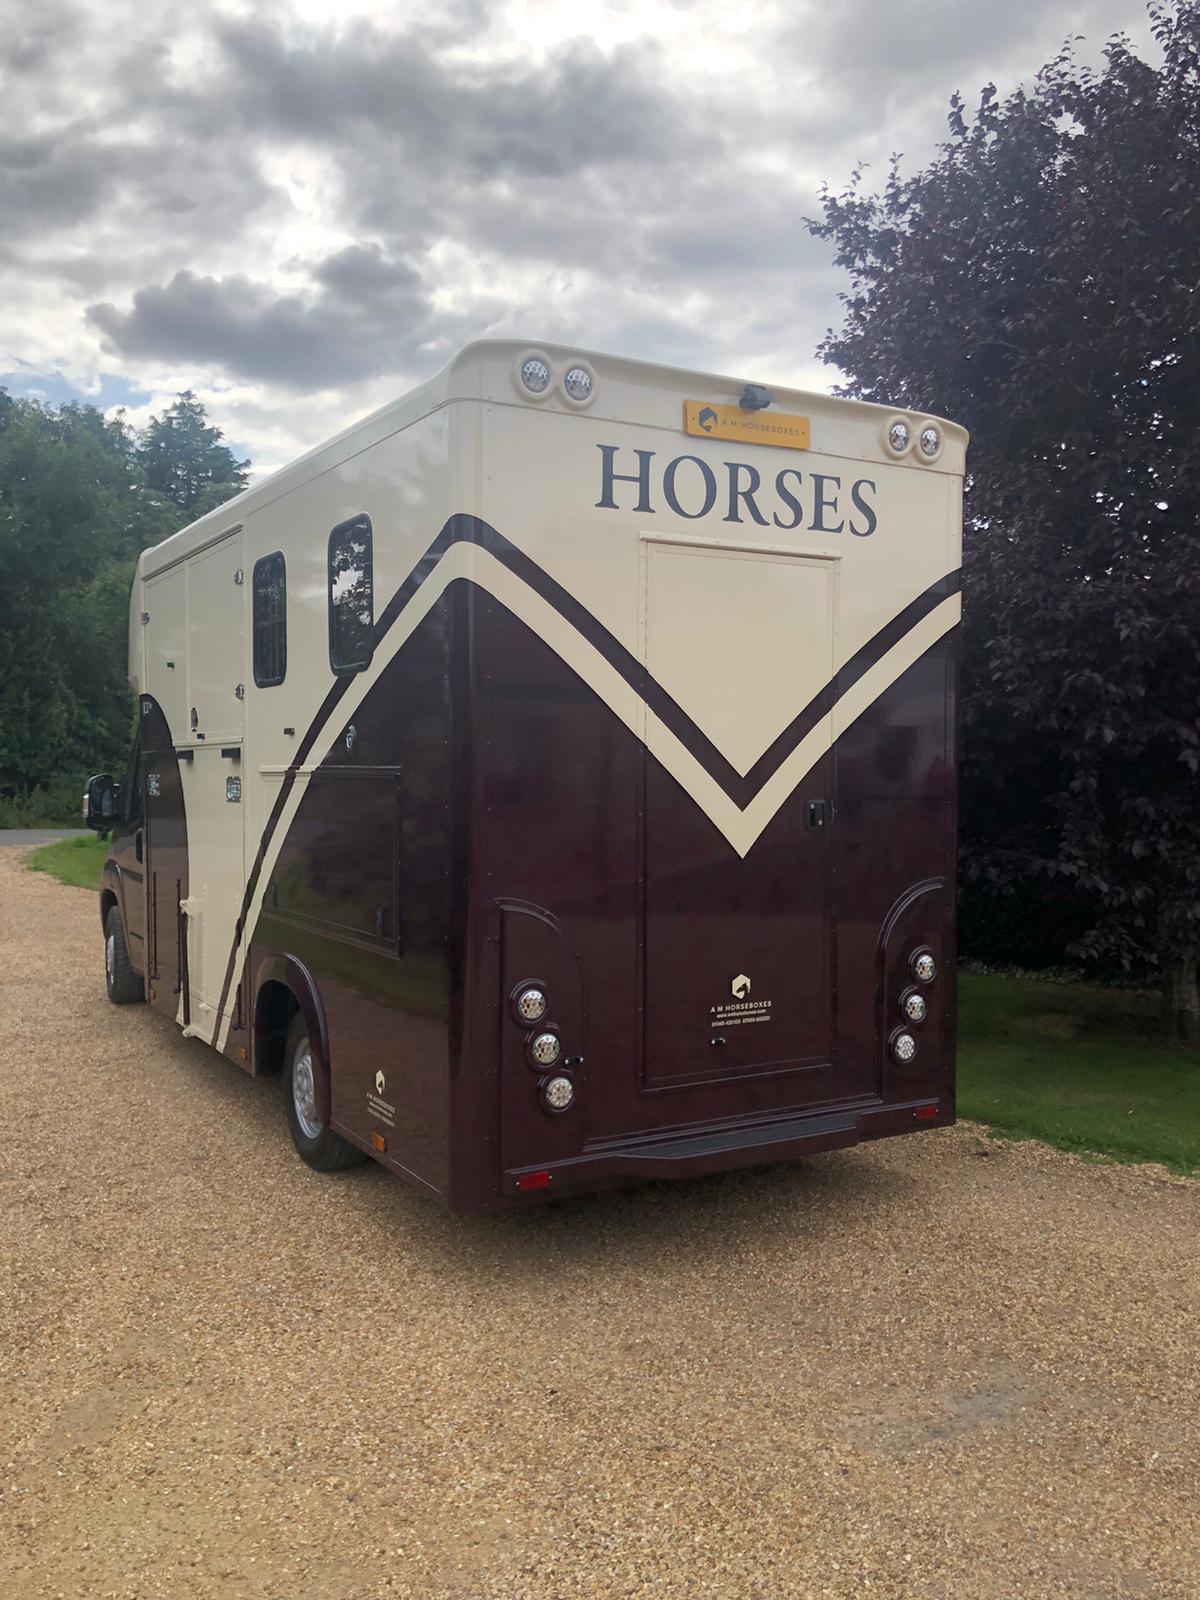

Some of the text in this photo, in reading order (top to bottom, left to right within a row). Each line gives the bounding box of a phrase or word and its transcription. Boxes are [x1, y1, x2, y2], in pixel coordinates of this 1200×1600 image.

[741, 421, 800, 437] HORSEBOXES
[595, 443, 878, 538] HORSES
[725, 1001, 772, 1011] HORSEBOXES
